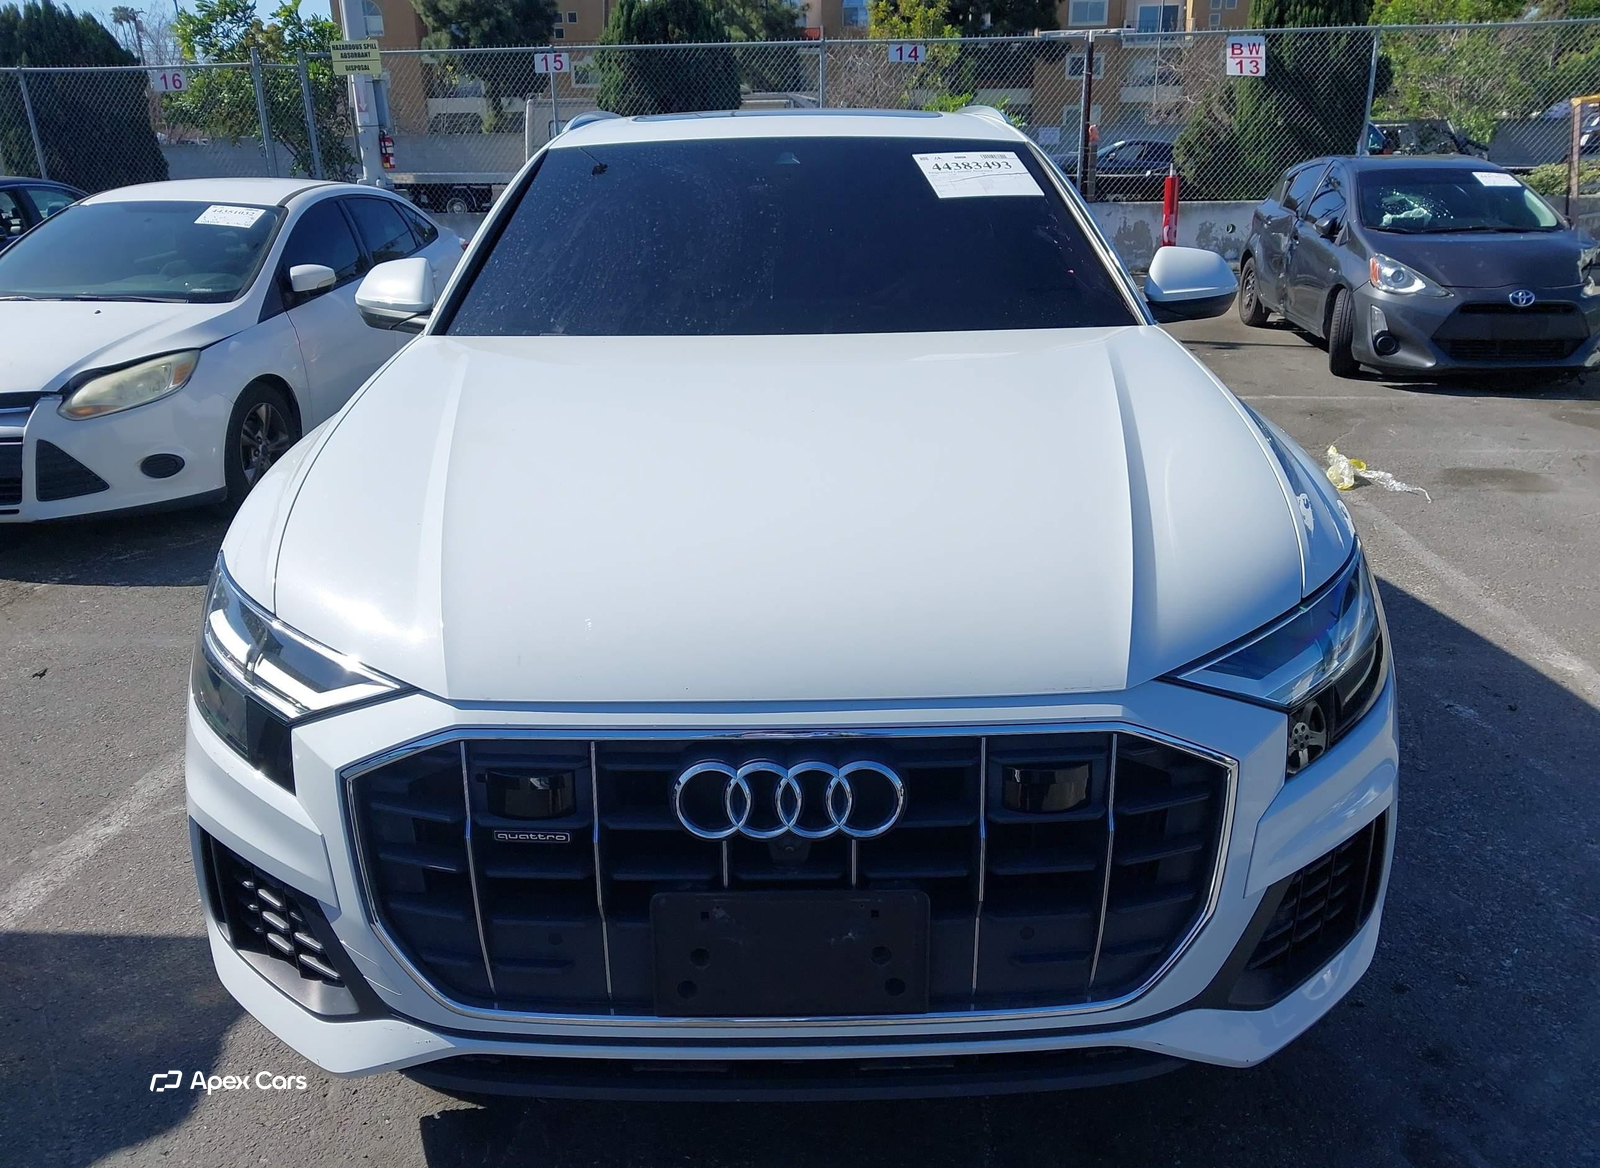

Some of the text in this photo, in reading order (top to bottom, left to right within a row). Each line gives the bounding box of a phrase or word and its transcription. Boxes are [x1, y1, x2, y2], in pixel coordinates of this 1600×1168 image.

[895, 45, 919, 61] 14
[541, 54, 564, 71] 15
[1235, 59, 1260, 74] 13
[160, 73, 182, 90] 16
[932, 161, 1012, 171] 44383493
[497, 833, 566, 841] quattro
